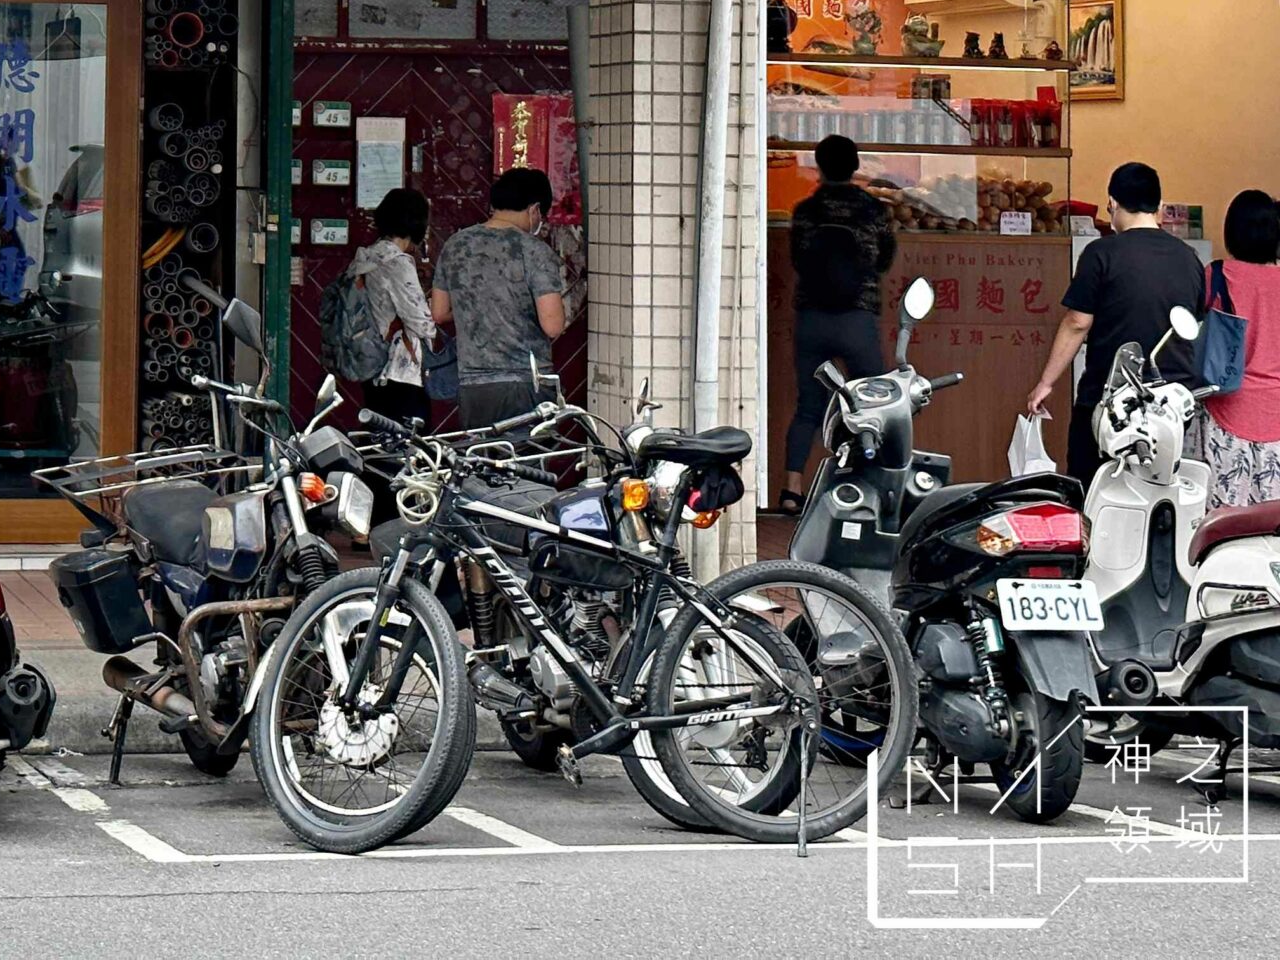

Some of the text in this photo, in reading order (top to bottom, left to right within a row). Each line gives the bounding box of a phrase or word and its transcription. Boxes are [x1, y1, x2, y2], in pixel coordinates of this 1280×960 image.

[325, 113, 338, 124] 45
[325, 171, 338, 182] 45
[323, 231, 336, 242] 45
[904, 253, 938, 267] Viet
[986, 253, 1045, 268] Bakery
